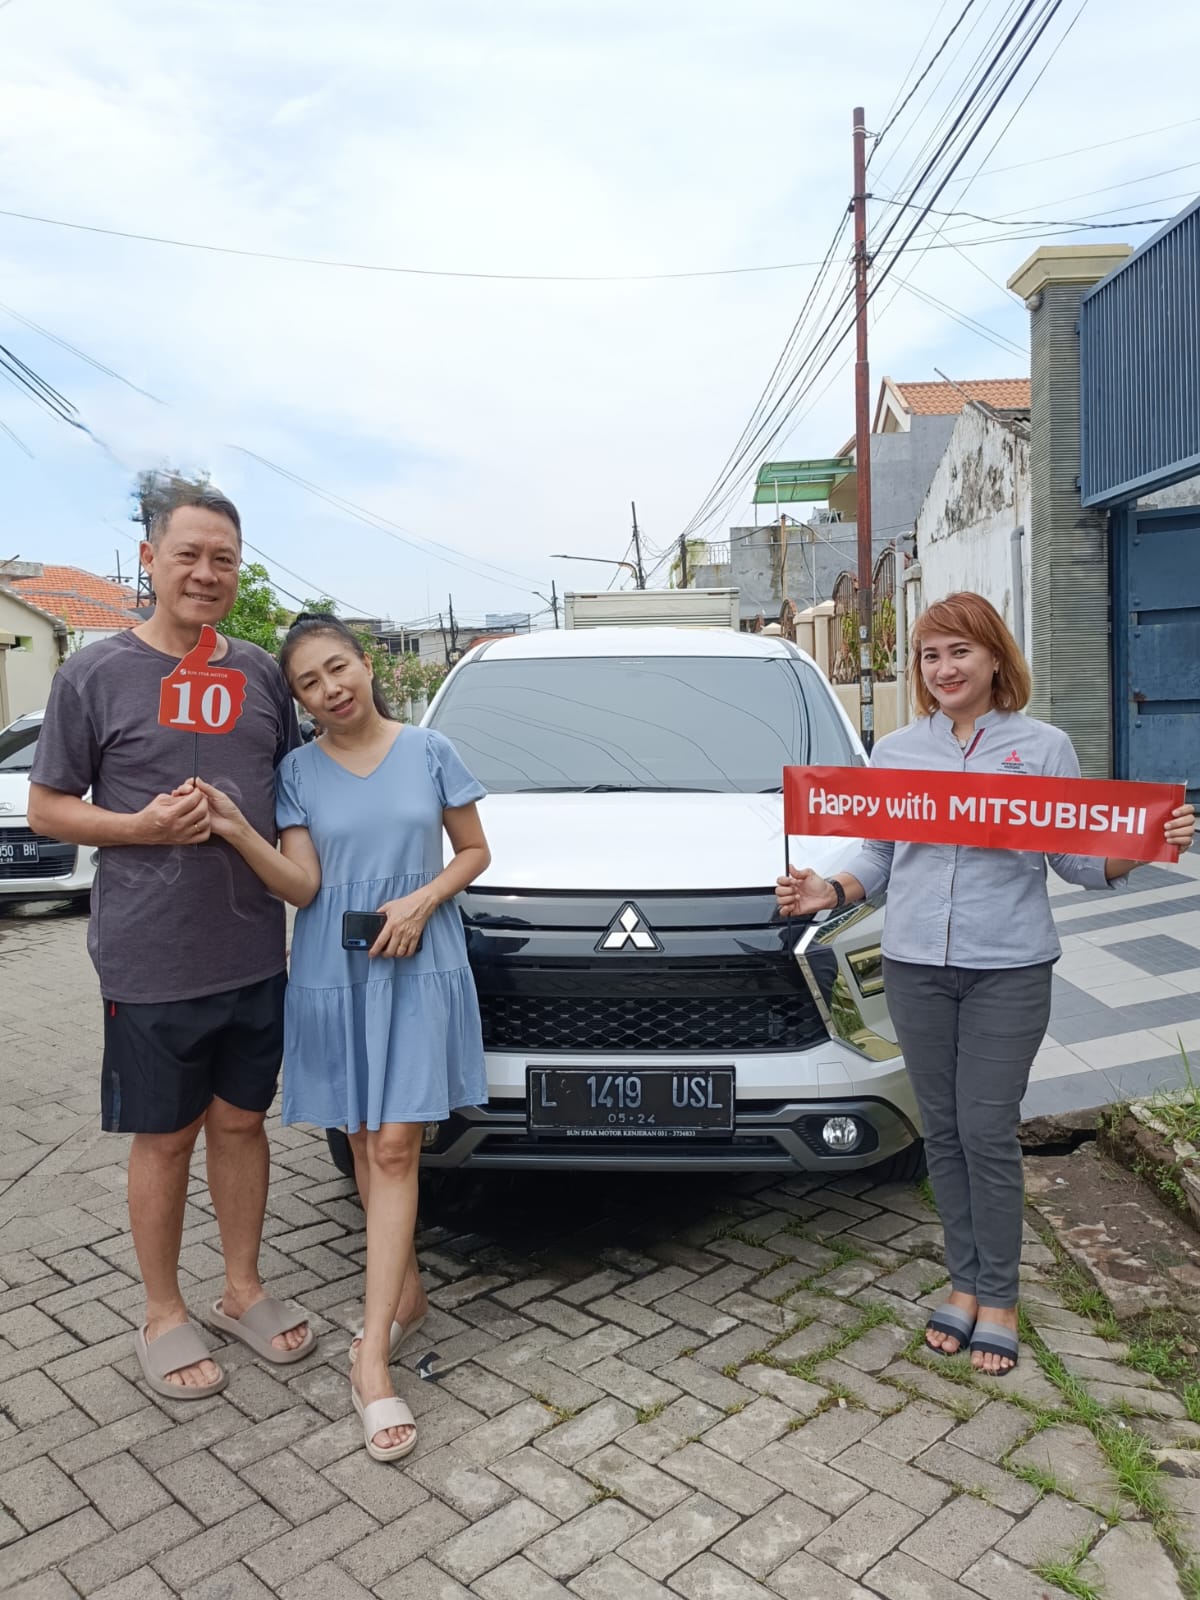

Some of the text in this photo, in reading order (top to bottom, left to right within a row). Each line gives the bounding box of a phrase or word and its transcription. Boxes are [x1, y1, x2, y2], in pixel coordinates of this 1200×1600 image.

[169, 681, 231, 727] 10
[809, 787, 1147, 835] Happy with MITSUBISHI
[23, 844, 36, 856] BH
[541, 1073, 723, 1109] L 1419 USL
